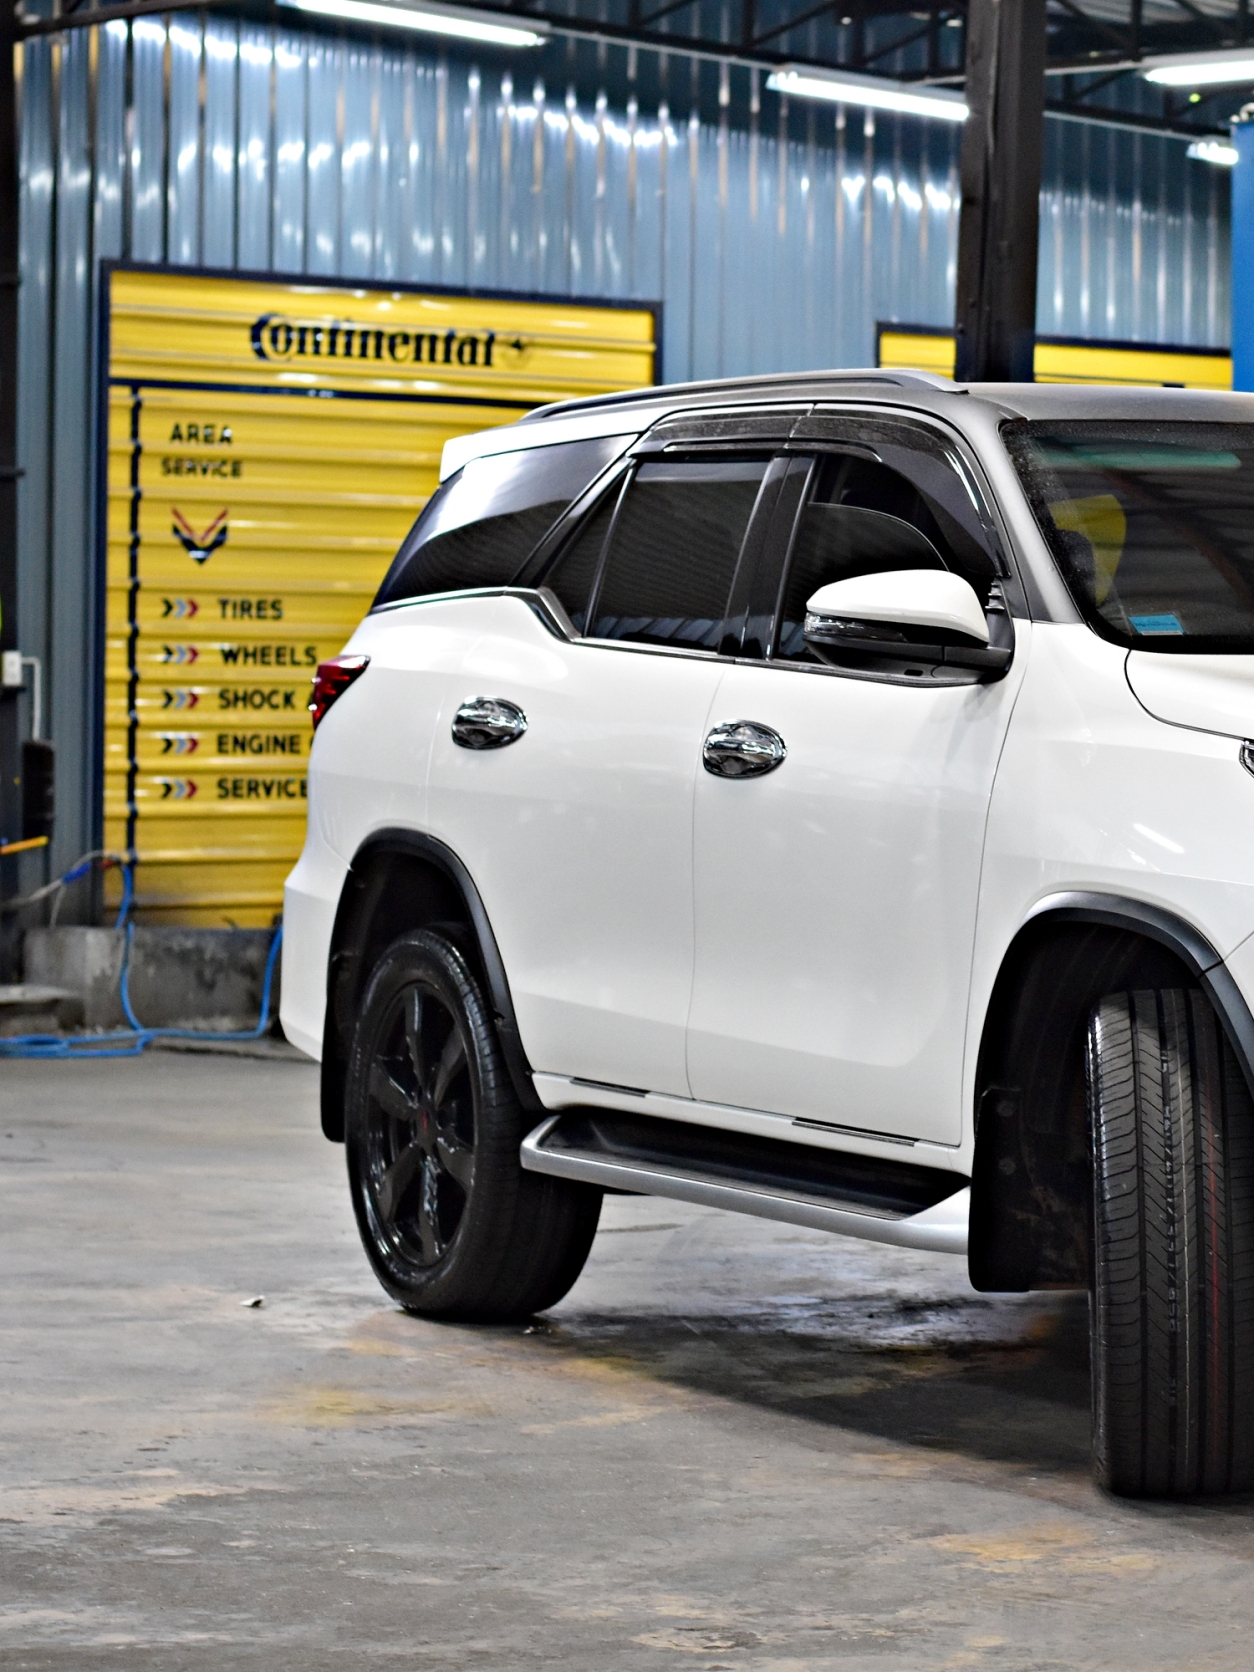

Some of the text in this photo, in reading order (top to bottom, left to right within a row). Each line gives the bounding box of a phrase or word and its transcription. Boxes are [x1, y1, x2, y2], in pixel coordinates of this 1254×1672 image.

[250, 312, 496, 368] Continental
[170, 423, 233, 444] AREA
[161, 457, 242, 478] SERVICE
[218, 598, 283, 621] TIRES
[220, 644, 318, 667] WHEELS
[218, 689, 296, 711] SHOCK
[217, 733, 302, 755] ENGINE
